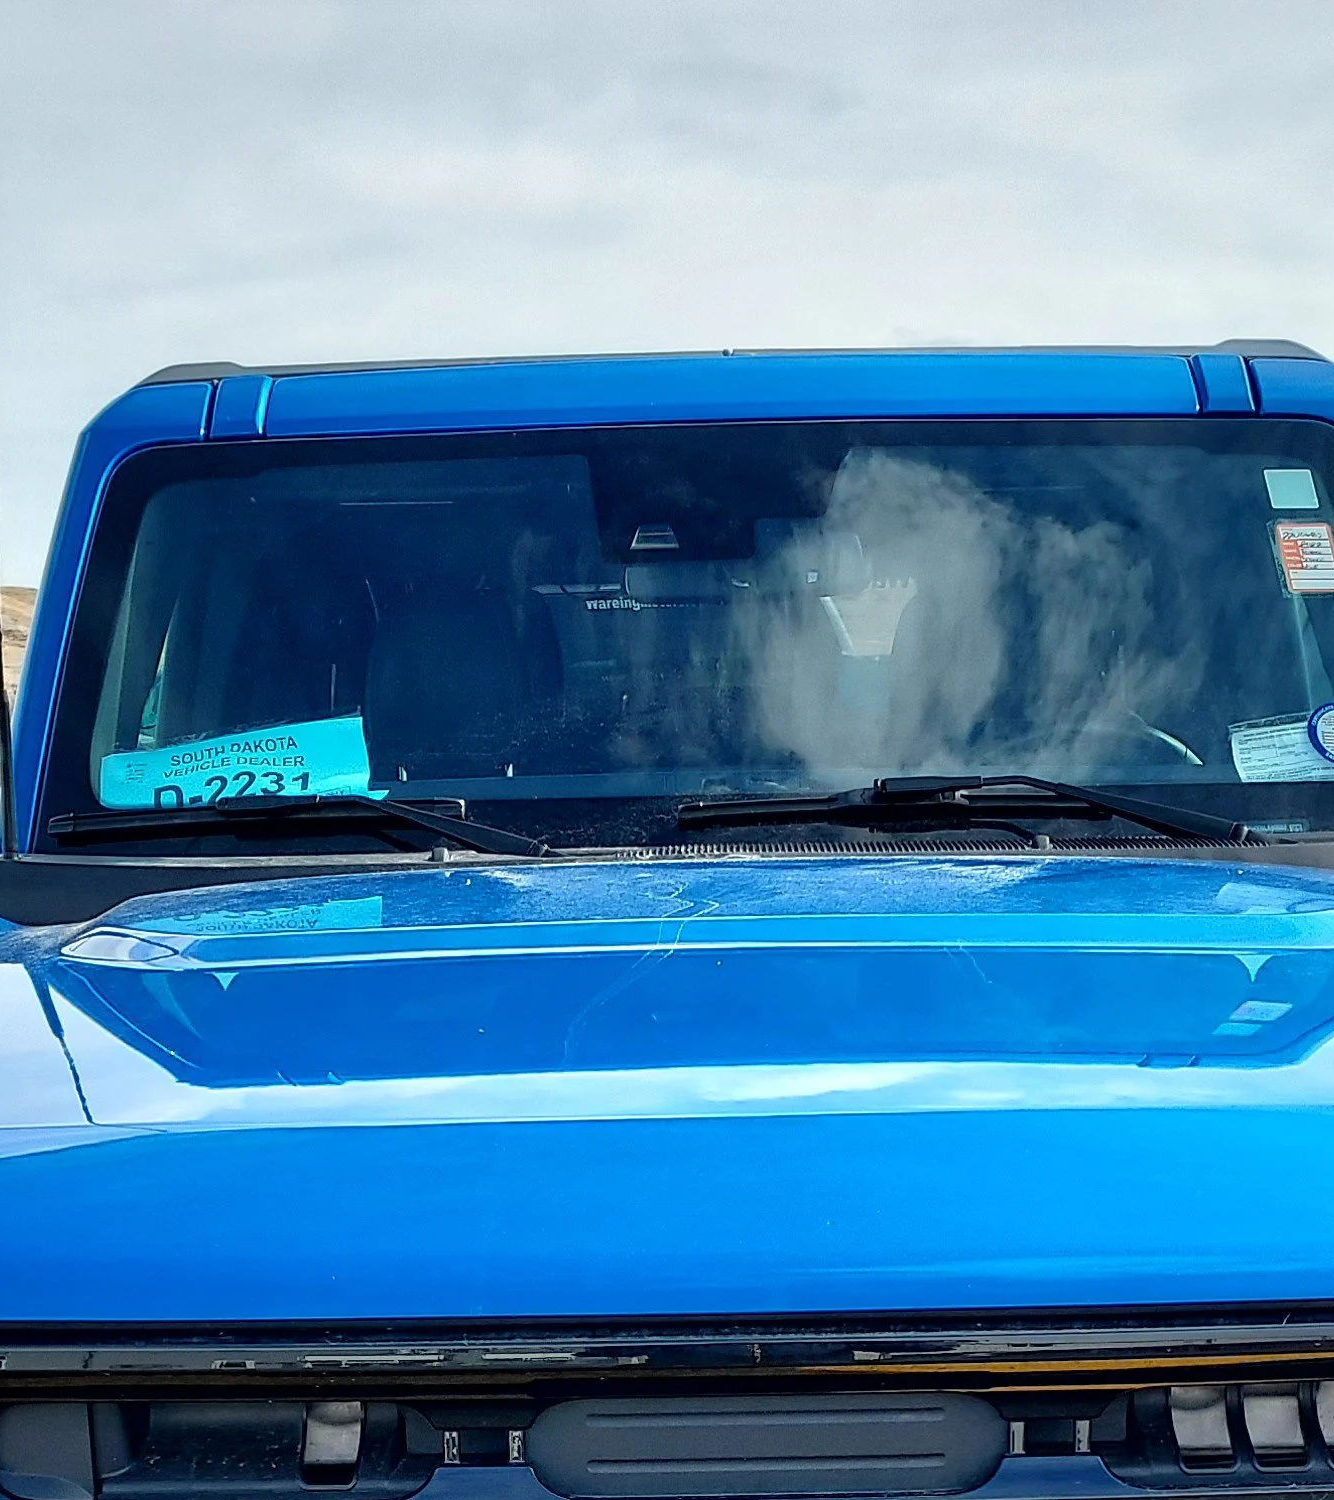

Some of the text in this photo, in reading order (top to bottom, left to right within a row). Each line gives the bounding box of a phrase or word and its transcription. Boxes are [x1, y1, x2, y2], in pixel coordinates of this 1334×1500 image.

[163, 757, 232, 778] VEHICLE
[236, 755, 305, 767] DEALER
[170, 735, 298, 768] SOUTH DAKOTA
[153, 770, 310, 808] D-2231
